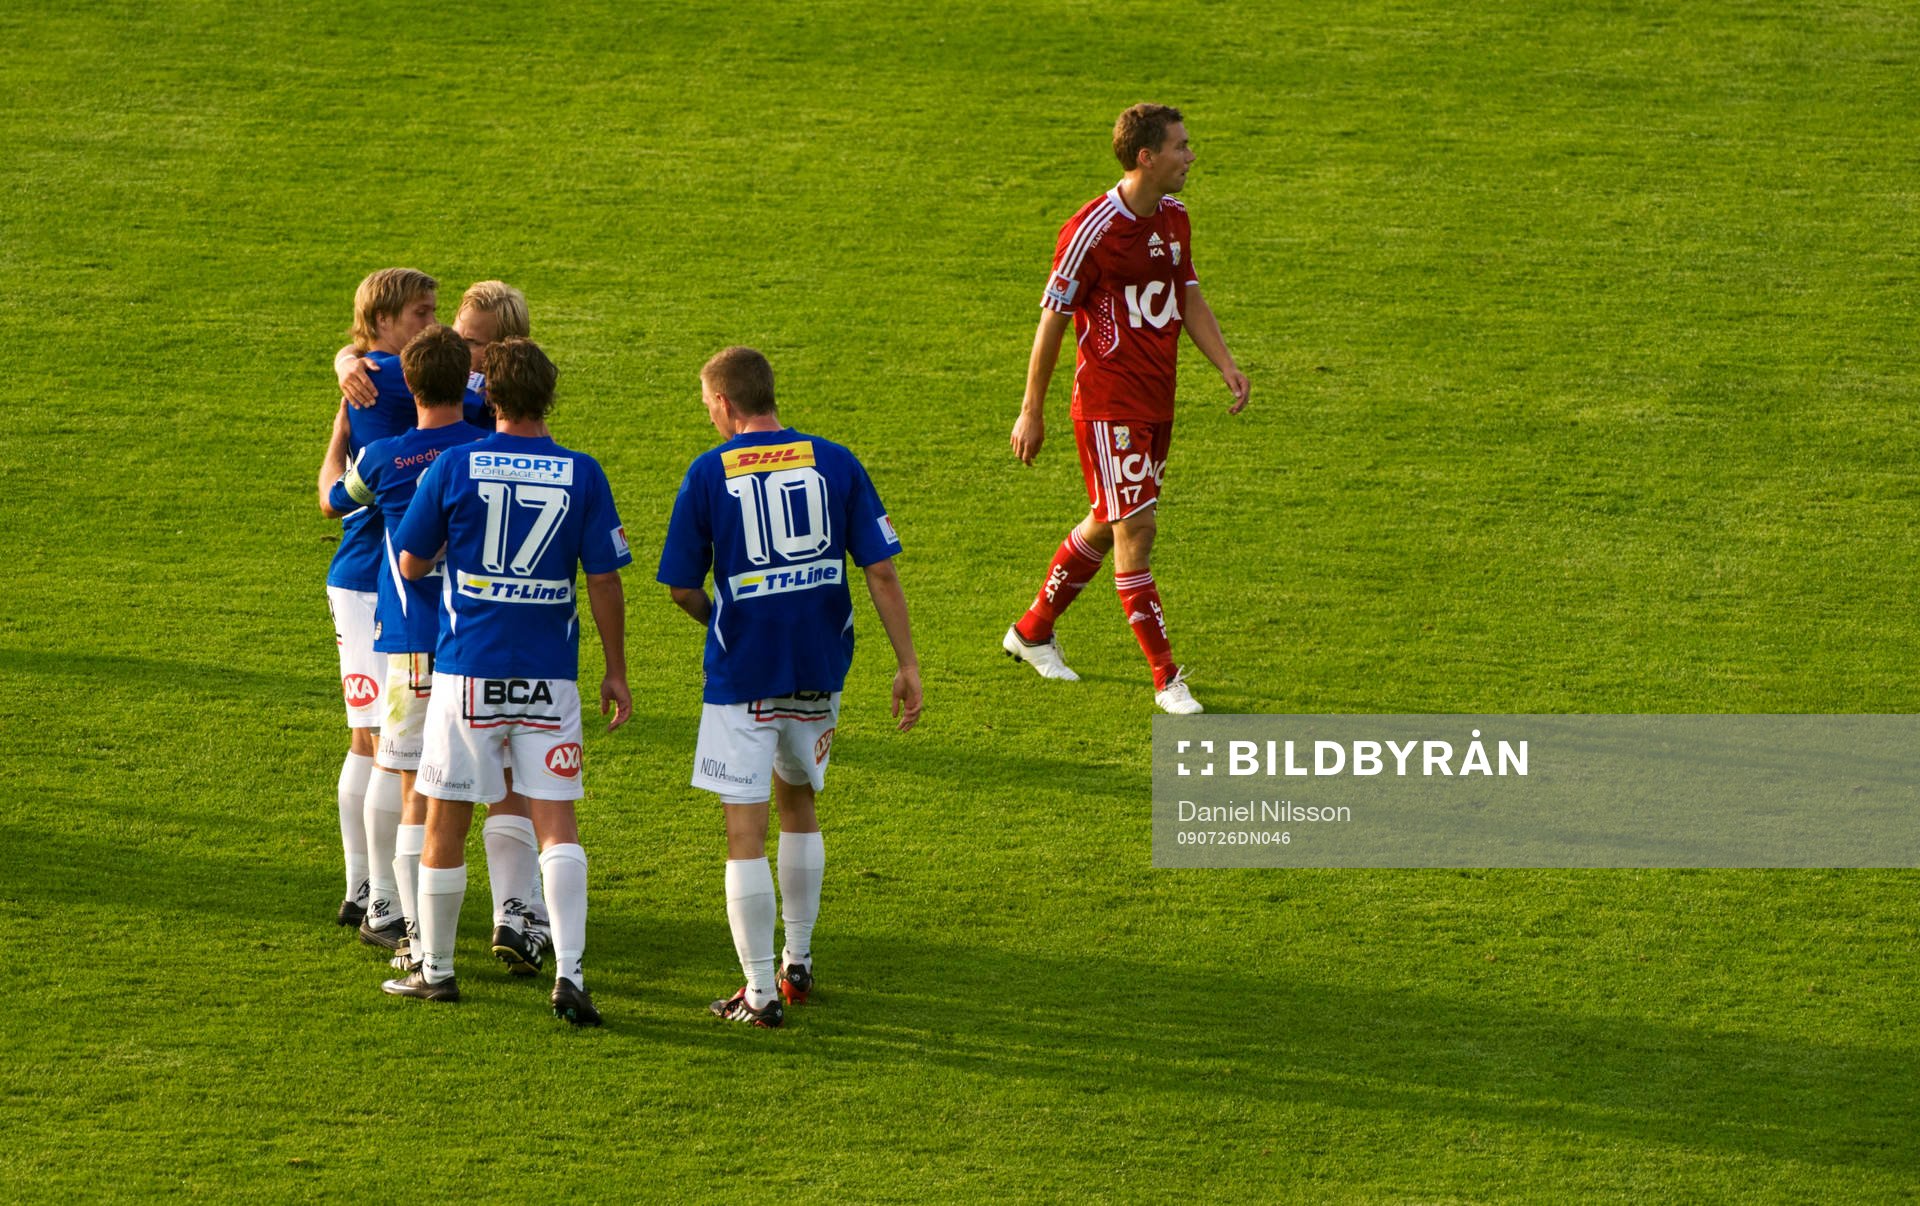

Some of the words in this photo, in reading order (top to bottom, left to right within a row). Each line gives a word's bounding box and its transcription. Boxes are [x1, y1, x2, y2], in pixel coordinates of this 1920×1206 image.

[1124, 279, 1182, 329] ICA
[475, 455, 569, 472] SPORT
[737, 448, 800, 467] DHL
[1112, 452, 1153, 484] ICA
[1120, 485, 1142, 504] 17
[725, 467, 831, 565] 10
[478, 482, 571, 577] 17
[766, 565, 838, 590] TT-Line
[1044, 564, 1068, 603] SKF
[491, 582, 569, 600] TT-Line
[484, 680, 553, 705] BCA
